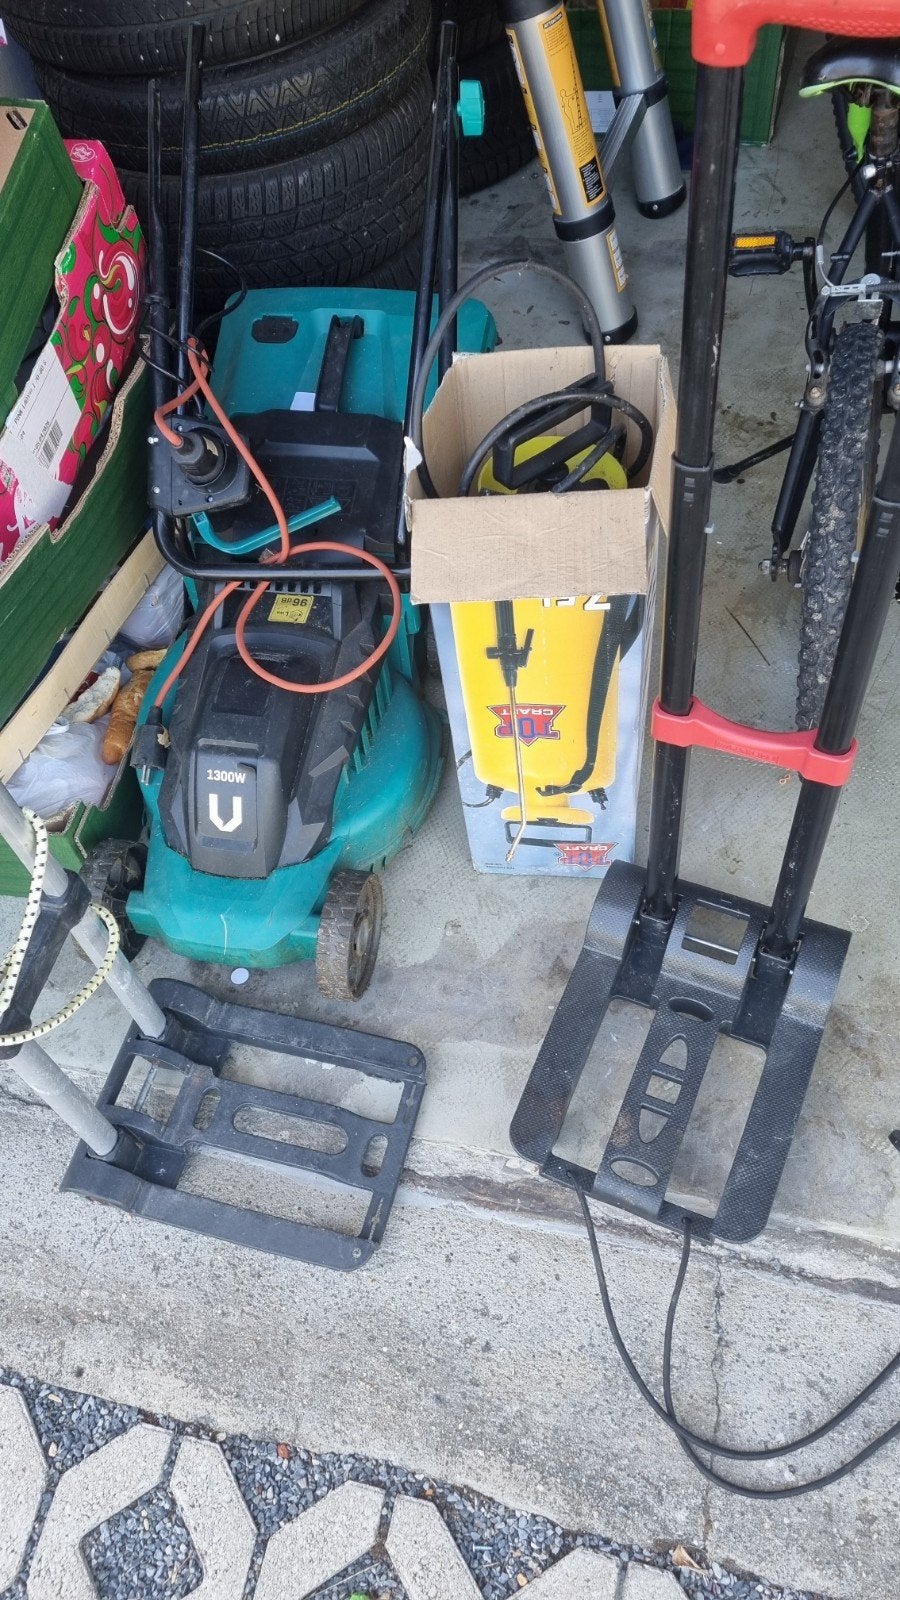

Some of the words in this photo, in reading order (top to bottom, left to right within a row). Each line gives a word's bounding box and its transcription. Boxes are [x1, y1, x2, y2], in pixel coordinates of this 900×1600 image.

[501, 708, 553, 716] CRAT
[497, 717, 559, 739] TOP
[206, 769, 246, 784] 1300W
